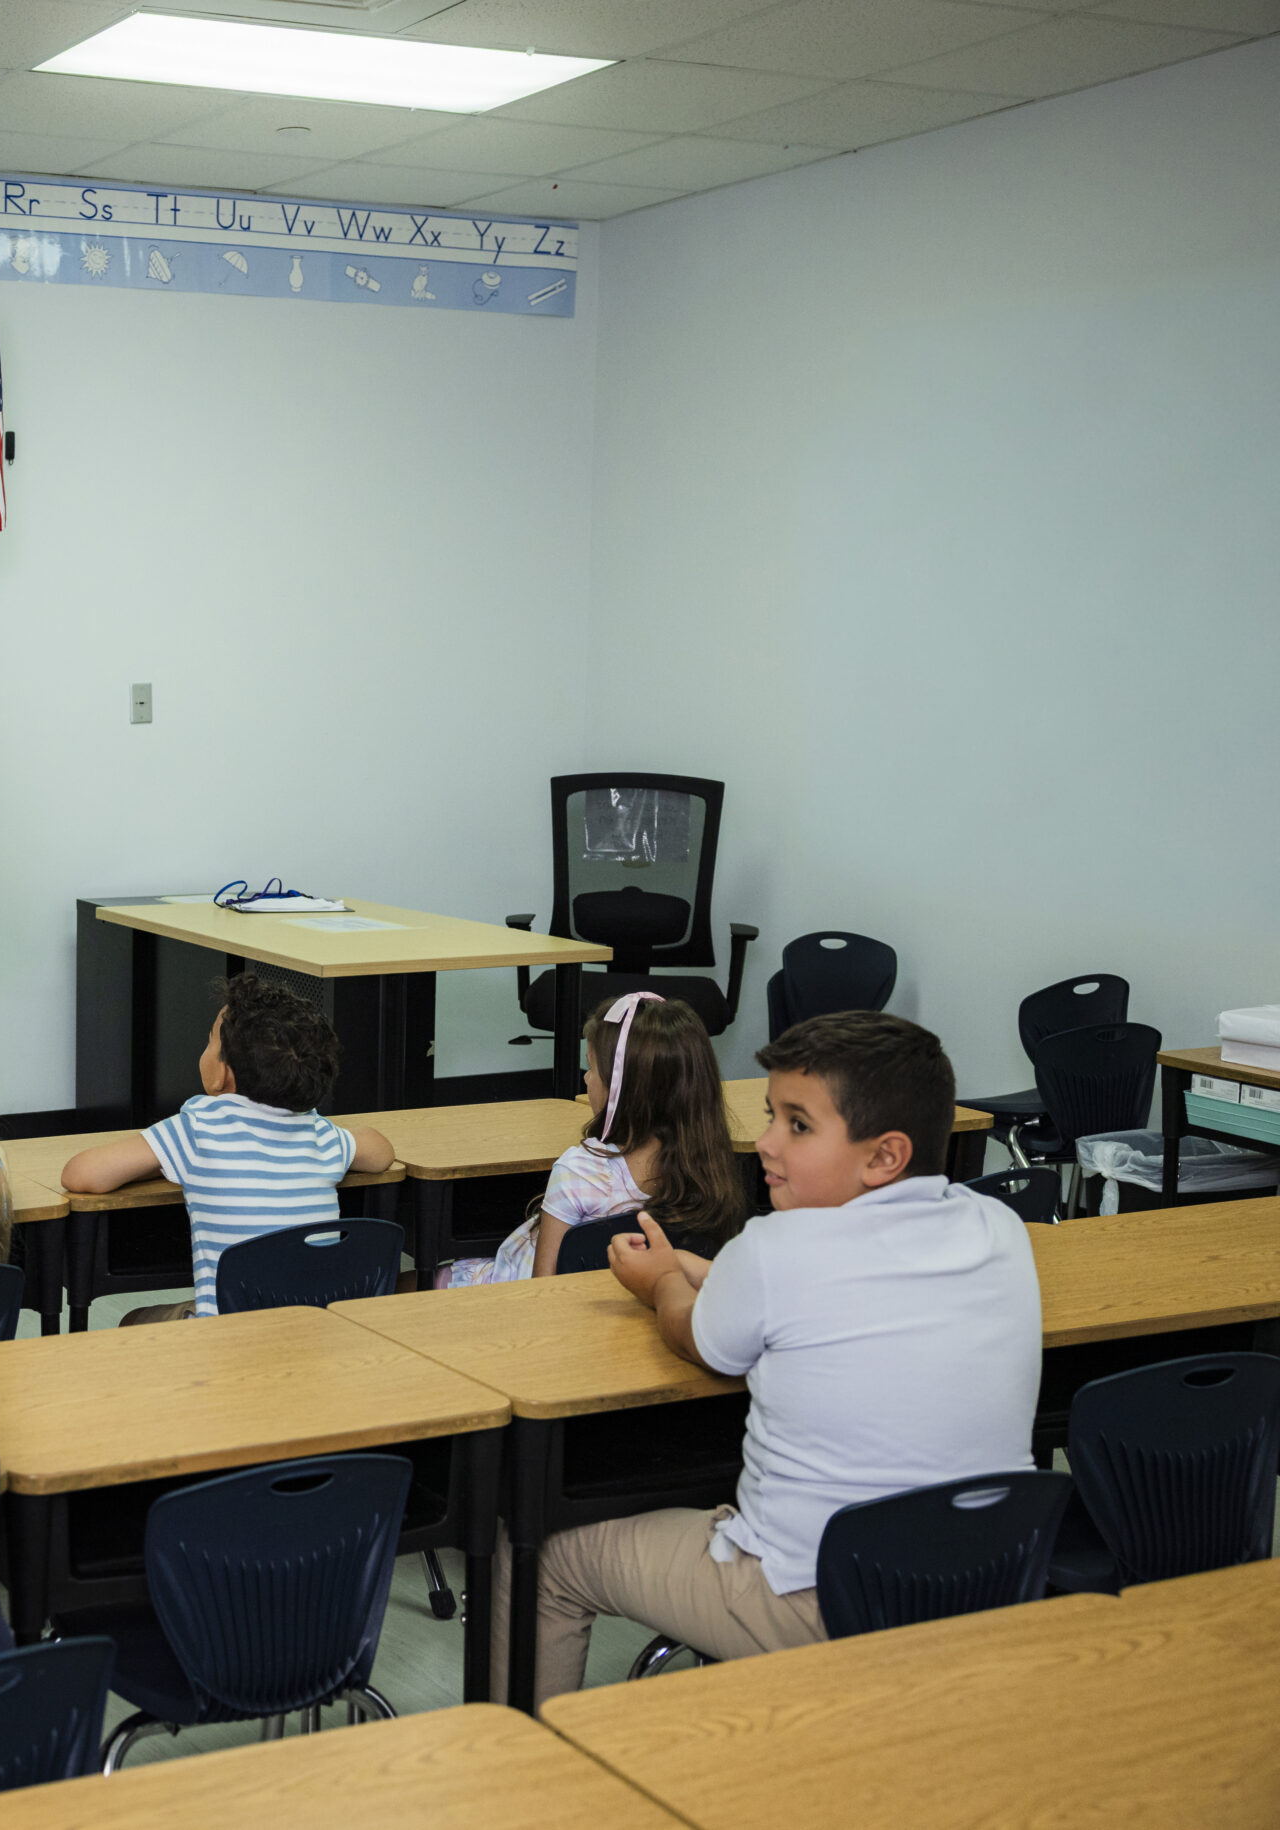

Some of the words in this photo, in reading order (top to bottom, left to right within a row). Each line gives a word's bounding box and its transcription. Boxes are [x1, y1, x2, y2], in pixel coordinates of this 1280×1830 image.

[4, 182, 40, 215] Rr
[79, 189, 113, 221] Ss
[146, 193, 181, 225] Tt
[216, 199, 251, 231] Uu
[281, 204, 315, 236] Vv
[336, 208, 393, 242] Ww
[408, 215, 442, 246] Xx
[472, 220, 506, 264] Yy
[532, 224, 566, 256] Zz
